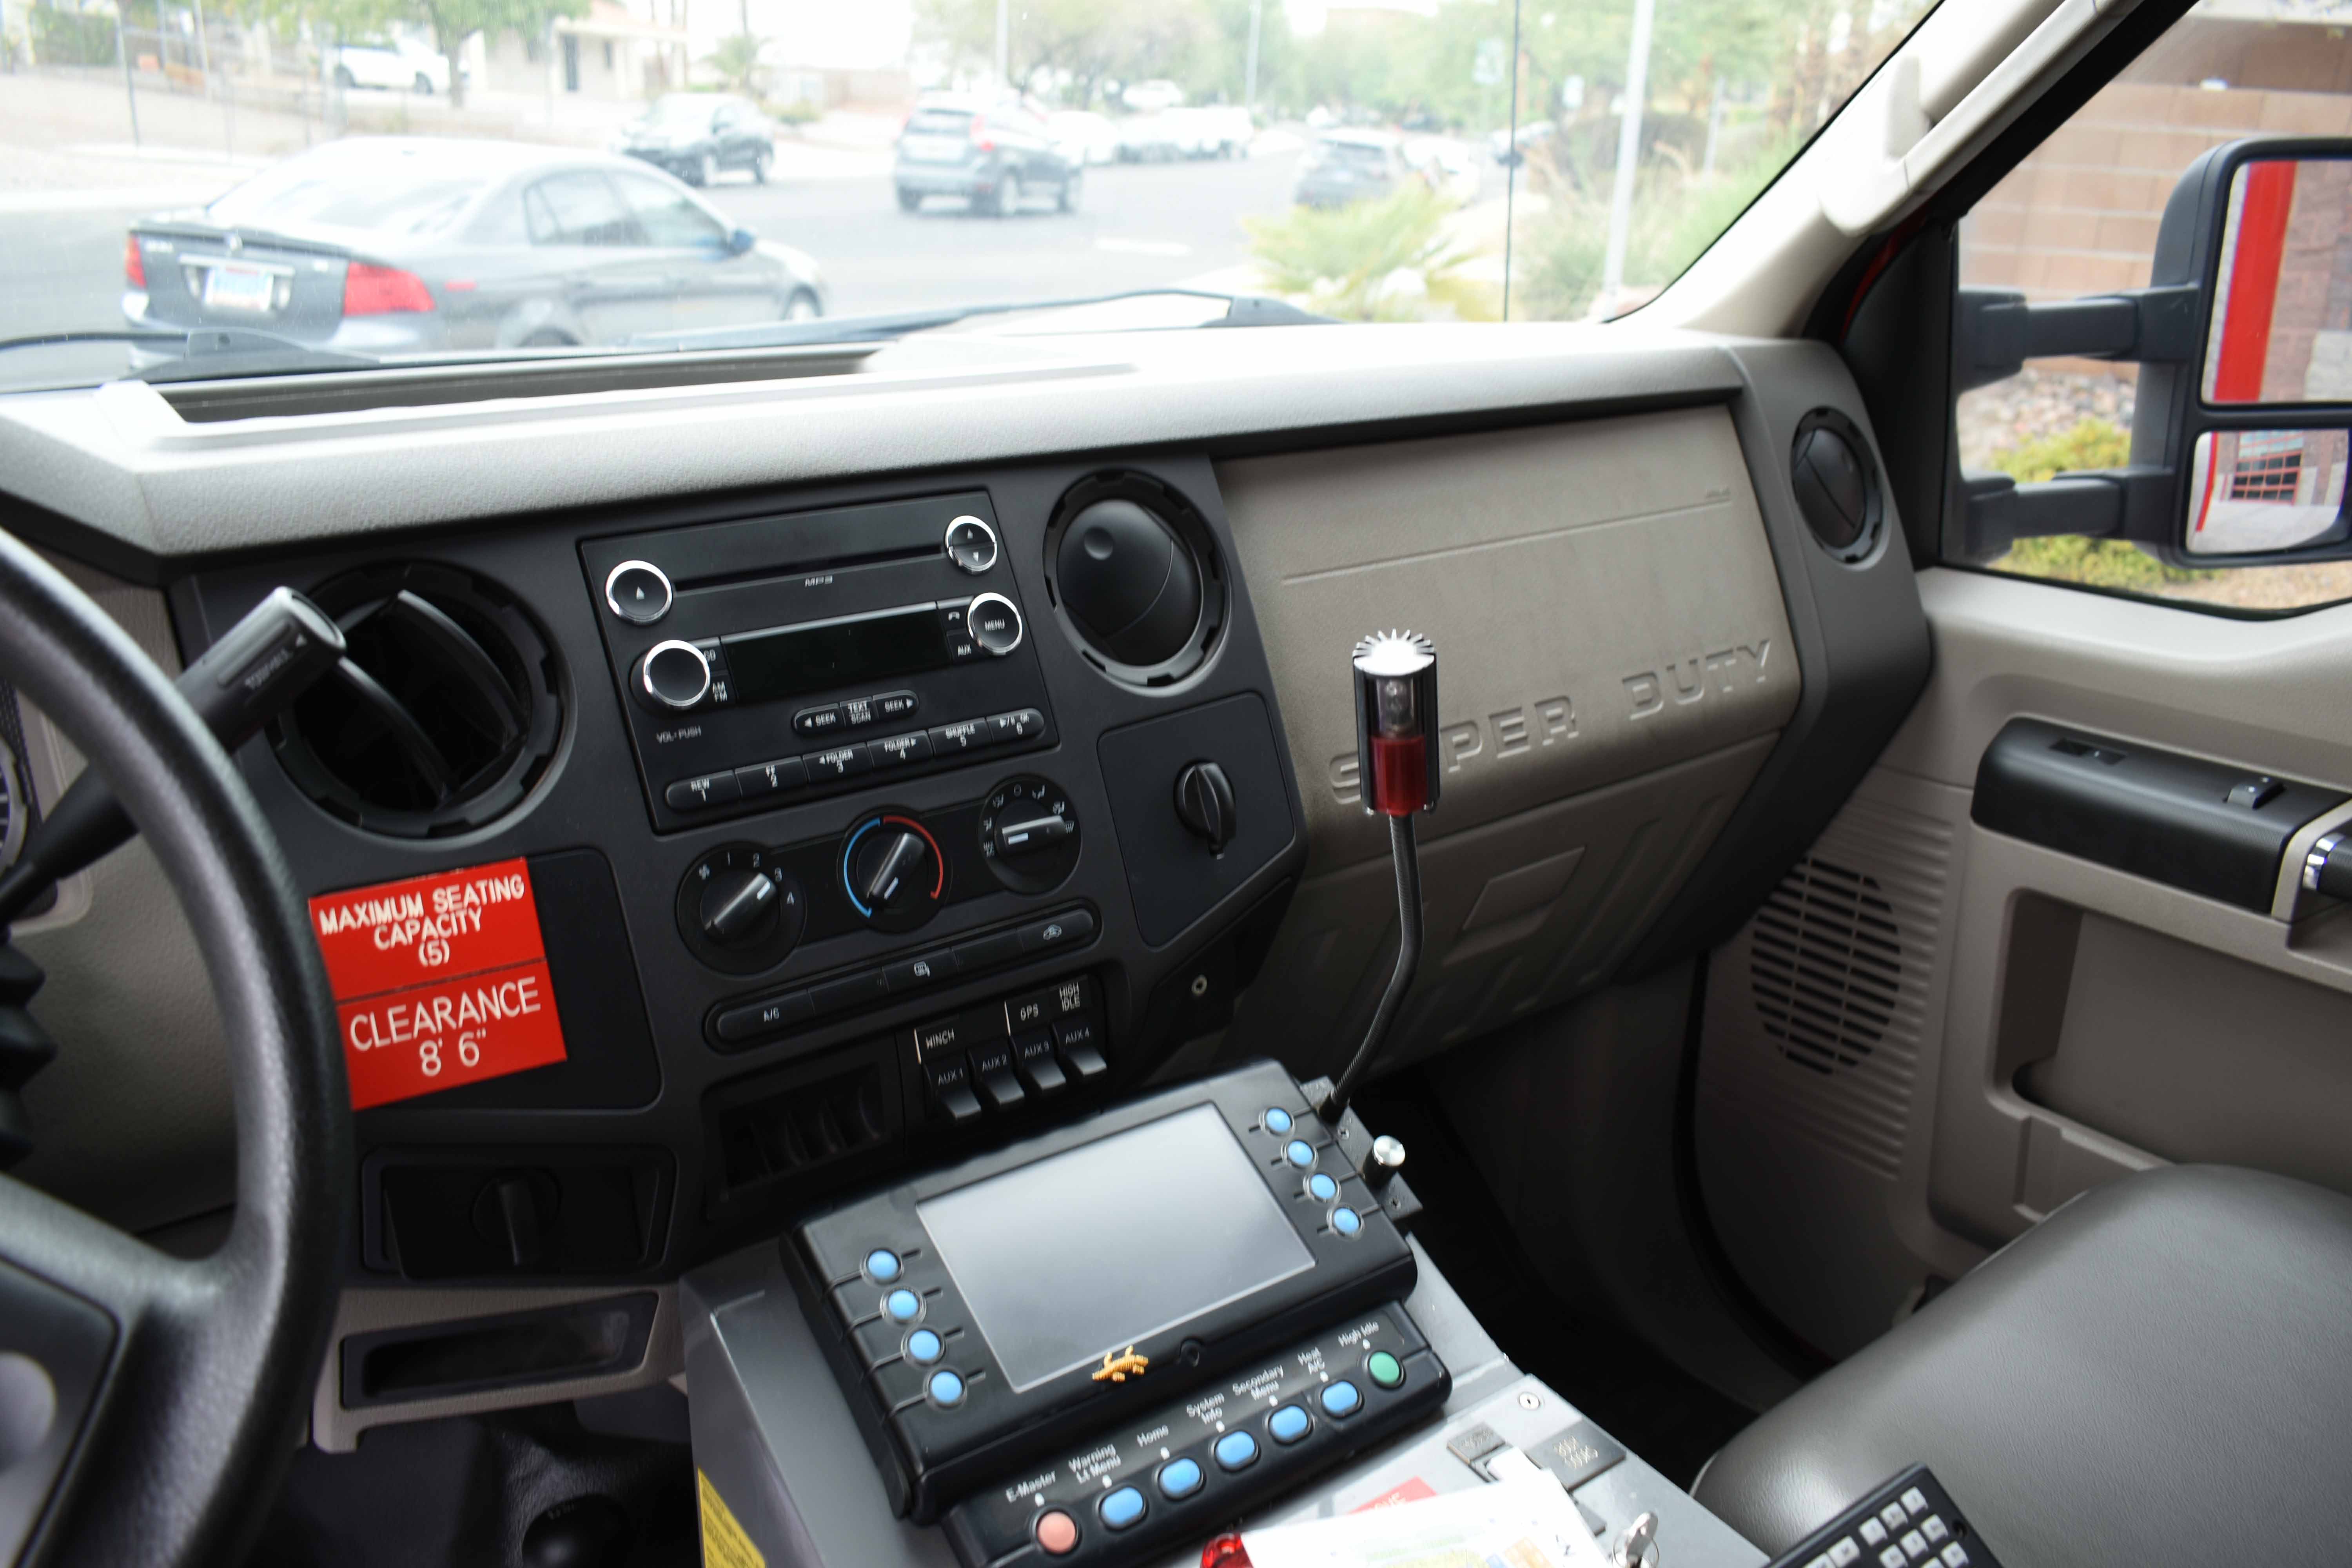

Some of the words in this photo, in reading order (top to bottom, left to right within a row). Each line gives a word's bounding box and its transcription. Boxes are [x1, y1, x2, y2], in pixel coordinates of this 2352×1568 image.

[805, 575, 833, 588] MP3
[985, 618, 1005, 632] MENU
[704, 649, 716, 662] CD
[958, 644, 971, 657] AUX
[713, 681, 725, 693] AM
[715, 689, 728, 702] FM
[848, 701, 867, 713] TEXT
[885, 699, 904, 712] SEEK
[815, 712, 836, 726] SEEK
[851, 711, 871, 724] SCAN
[1329, 695, 1579, 804] SPER
[1622, 639, 1771, 721] DUTY
[945, 723, 975, 739] SHUFFLE
[1016, 722, 1023, 735] 6
[884, 738, 910, 753] FOLDER
[960, 735, 966, 747] 5
[826, 749, 853, 764] FOLDER
[900, 748, 906, 759] 4
[765, 765, 776, 777] FF
[837, 760, 844, 773] 3
[691, 778, 710, 792] REW
[770, 774, 778, 788] 2
[701, 789, 706, 802] 1
[753, 853, 760, 868] 2
[774, 867, 782, 882] 3
[319, 892, 424, 935] MAXIMUM
[432, 874, 524, 913] SEATING
[787, 891, 794, 905] 4
[374, 907, 482, 950] CAPACITY
[419, 939, 450, 967] (5)
[1059, 982, 1079, 1000] HIGH
[1062, 994, 1080, 1012] IDLE
[350, 976, 541, 1051] CLEARANCE
[764, 1007, 780, 1022] A/C
[1020, 1003, 1039, 1020] GPS
[925, 1029, 954, 1049] WINCH
[1065, 1029, 1083, 1044] AUX
[1085, 1027, 1090, 1038] 4
[419, 1037, 443, 1077] 8'
[458, 1028, 486, 1067] 6"
[1025, 1044, 1042, 1059] AUX
[1044, 1041, 1049, 1052] 3
[982, 1057, 1000, 1072] AUX
[1002, 1054, 1007, 1065] 2
[938, 1071, 957, 1086] AUX
[959, 1068, 963, 1079] 1
[1338, 1329, 1361, 1347] High
[1360, 1321, 1379, 1336] Idle
[1297, 1347, 1321, 1366] Heat
[1232, 1365, 1284, 1396] Secondary
[1251, 1380, 1279, 1401] Menu
[1186, 1392, 1225, 1417] System
[1137, 1425, 1169, 1447] Home
[1068, 1443, 1116, 1473] Warning
[1089, 1455, 1121, 1477] Menu
[1005, 1470, 1056, 1503] E-Master
